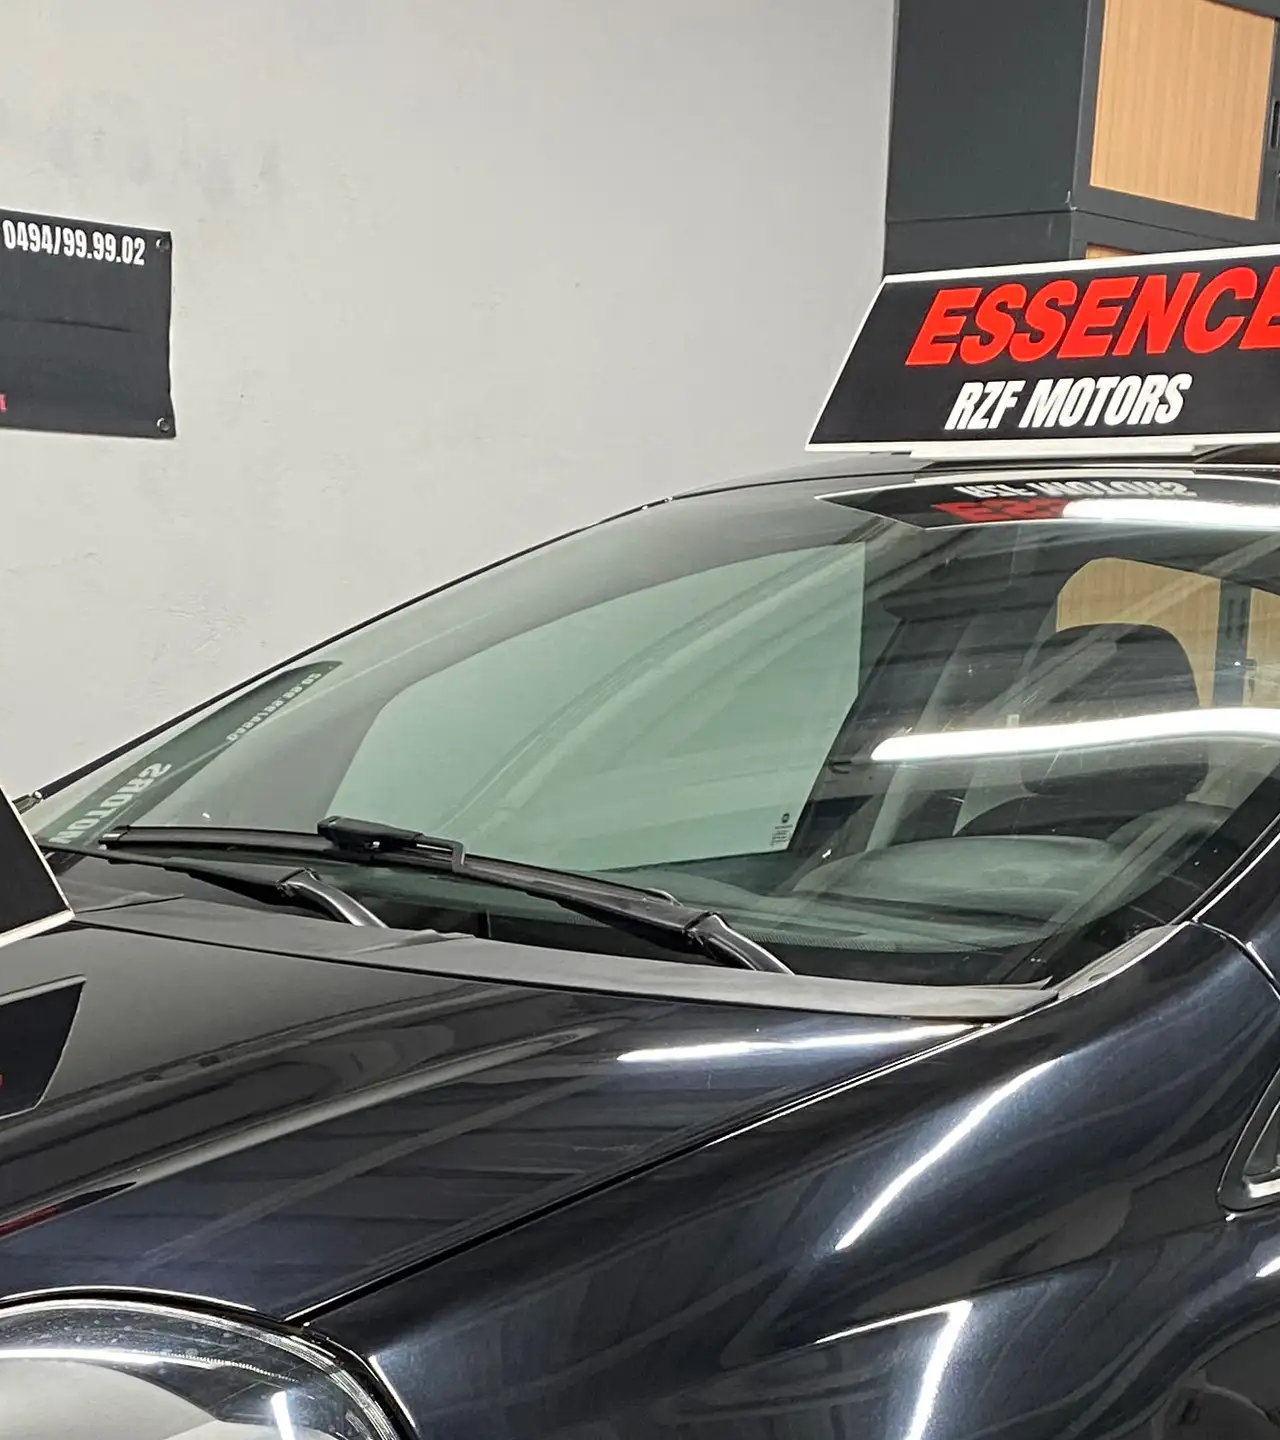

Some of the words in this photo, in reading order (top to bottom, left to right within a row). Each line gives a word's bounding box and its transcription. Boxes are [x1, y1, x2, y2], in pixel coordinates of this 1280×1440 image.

[2, 219, 146, 266] 0494/99.99.02
[944, 380, 1027, 431] RZF
[1019, 373, 1193, 429] MOTORS
